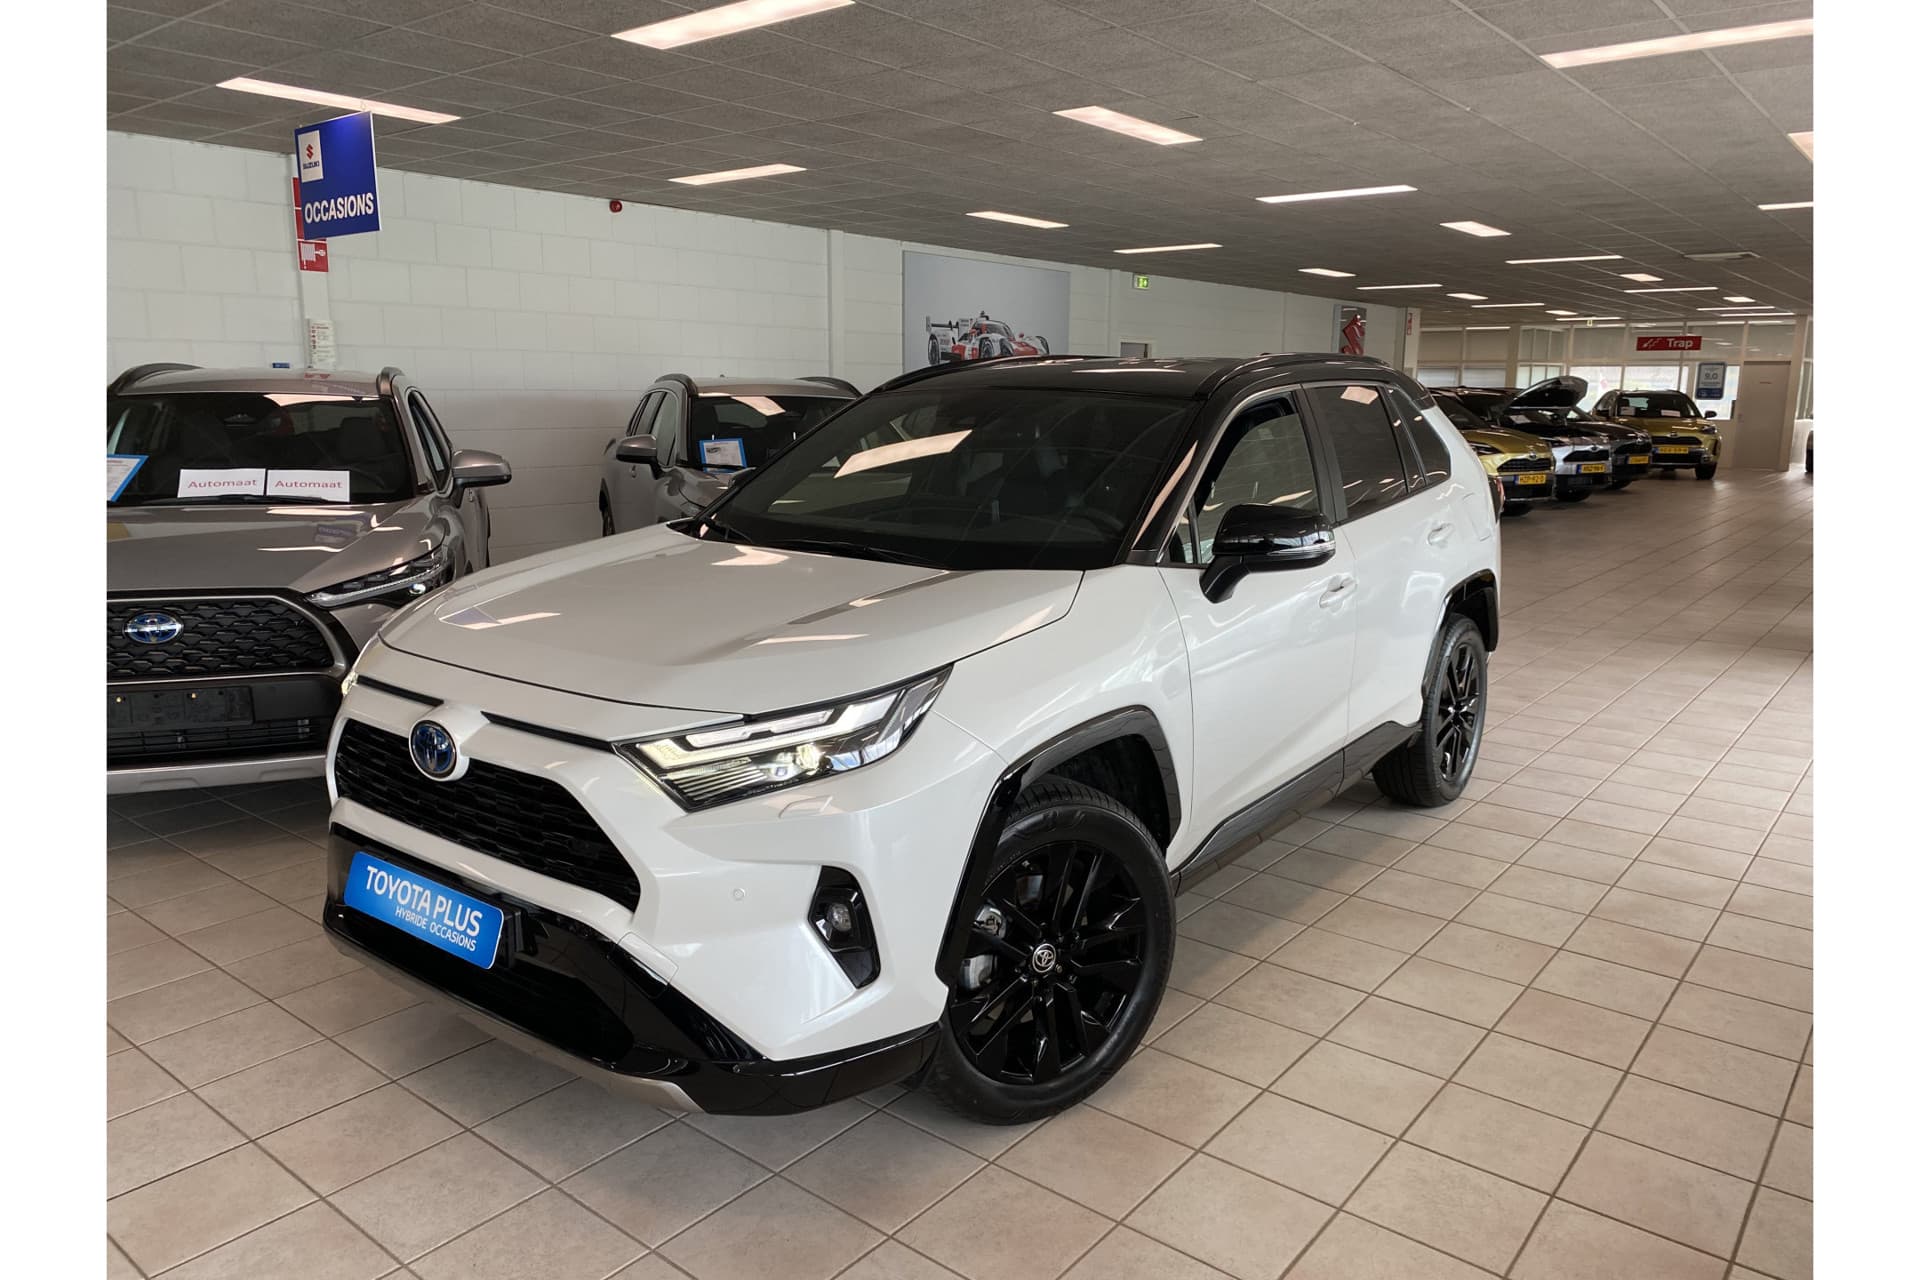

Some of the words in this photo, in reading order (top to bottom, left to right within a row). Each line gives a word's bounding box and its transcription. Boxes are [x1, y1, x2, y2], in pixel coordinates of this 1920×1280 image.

[303, 160, 320, 170] SUZUKI
[304, 192, 374, 224] OCCASIONS
[1666, 338, 1693, 349] Trap
[188, 479, 257, 488] Automaat
[274, 480, 343, 489] Automaat
[366, 865, 432, 916] TOYOTA
[433, 894, 483, 937] PLUS
[395, 906, 429, 930] HYBRIDE
[430, 921, 477, 952] OCCASIONS
